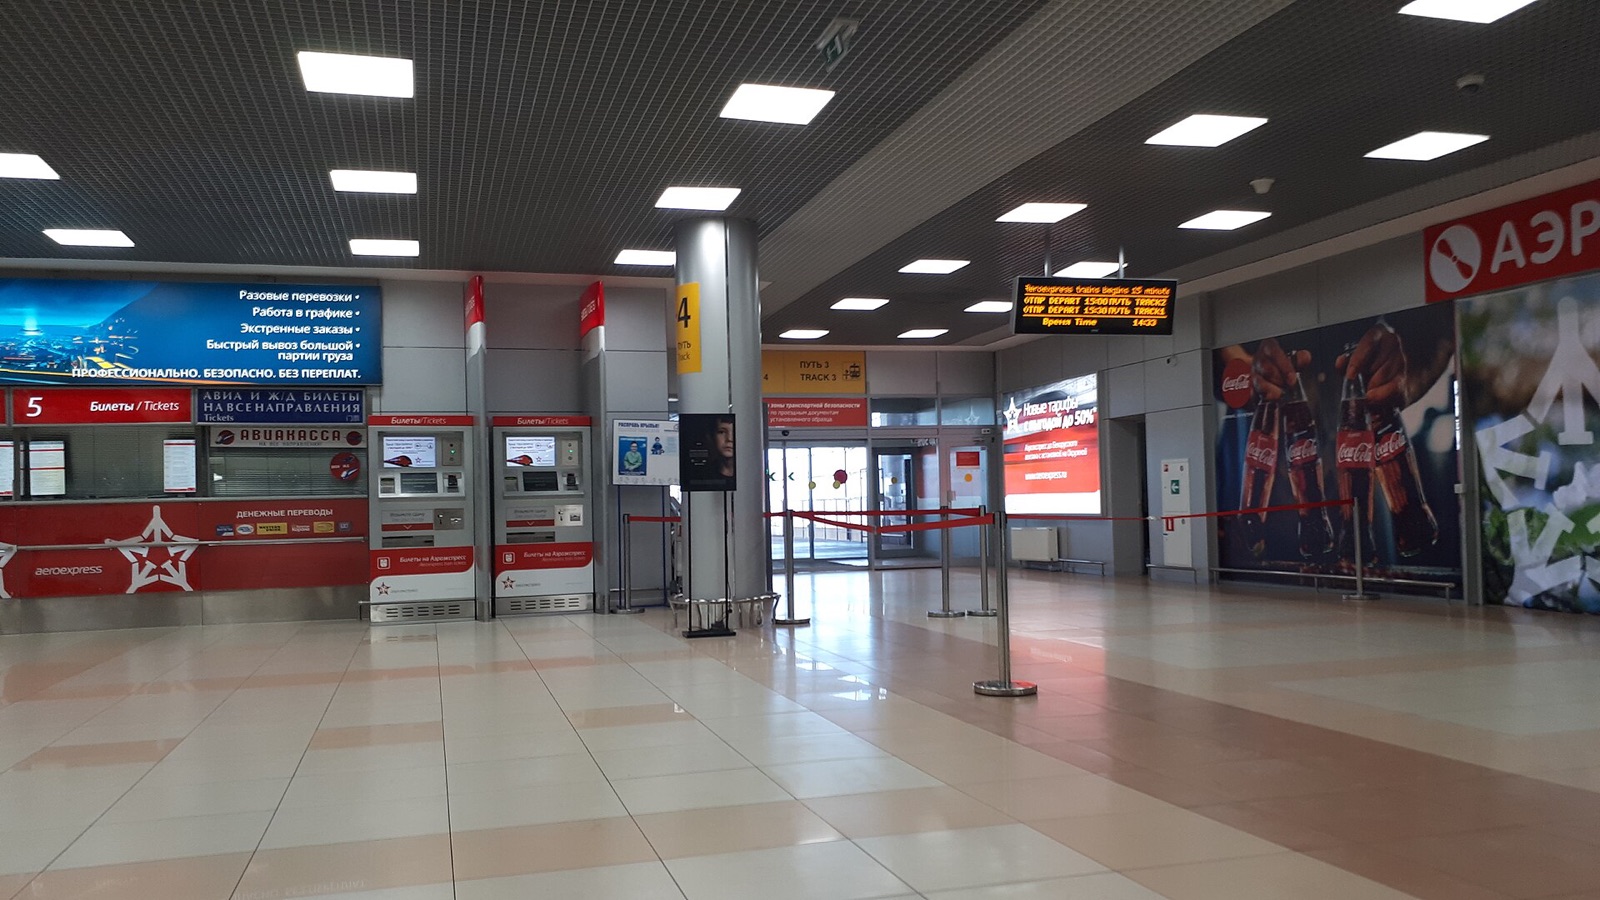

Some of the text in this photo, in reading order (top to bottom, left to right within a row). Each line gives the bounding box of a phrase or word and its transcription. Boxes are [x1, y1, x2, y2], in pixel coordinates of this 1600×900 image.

[1490, 200, 1600, 274] АЭР
[239, 290, 352, 303] Разовые перевозки
[1101, 286, 1130, 296] begins
[1131, 286, 1143, 294] 15
[1023, 296, 1046, 305] ОТПР
[1048, 297, 1081, 305] DEPART
[1084, 298, 1108, 306] 15:00
[1108, 298, 1132, 306] ПУТЬ
[252, 307, 353, 320] Работа в графике
[677, 297, 691, 328] 4
[1022, 305, 1045, 314] ОТПР
[1047, 306, 1081, 314] DEPART
[1083, 307, 1107, 315] 15:30
[1107, 307, 1131, 315] ПУТЬ
[1074, 318, 1097, 327] Time
[1132, 319, 1157, 327] 14:33
[240, 323, 353, 334] Экстренные заказы
[206, 339, 353, 351] Быстрый вывоз большой
[277, 351, 353, 363] партии груза
[800, 361, 830, 369] ПУТЬ 3
[72, 368, 361, 378] ПРОФЕССИОНАЛЬНО. БЕЗОПАСНО. БЕЗ ПЕРЕПЛАТ.
[1222, 374, 1250, 391] Coca-Cola
[203, 391, 360, 402] АВИА И Ж/Д БИЛЕТЫ
[26, 396, 43, 417] 5
[90, 402, 134, 412] Билеты
[144, 401, 180, 411] Tickets
[1023, 403, 1047, 417] Новые
[204, 413, 234, 422] Tickets
[240, 429, 341, 441] АВИАКАССА
[1338, 443, 1374, 463] Coca-Cola
[35, 565, 103, 576] aeroexpress
